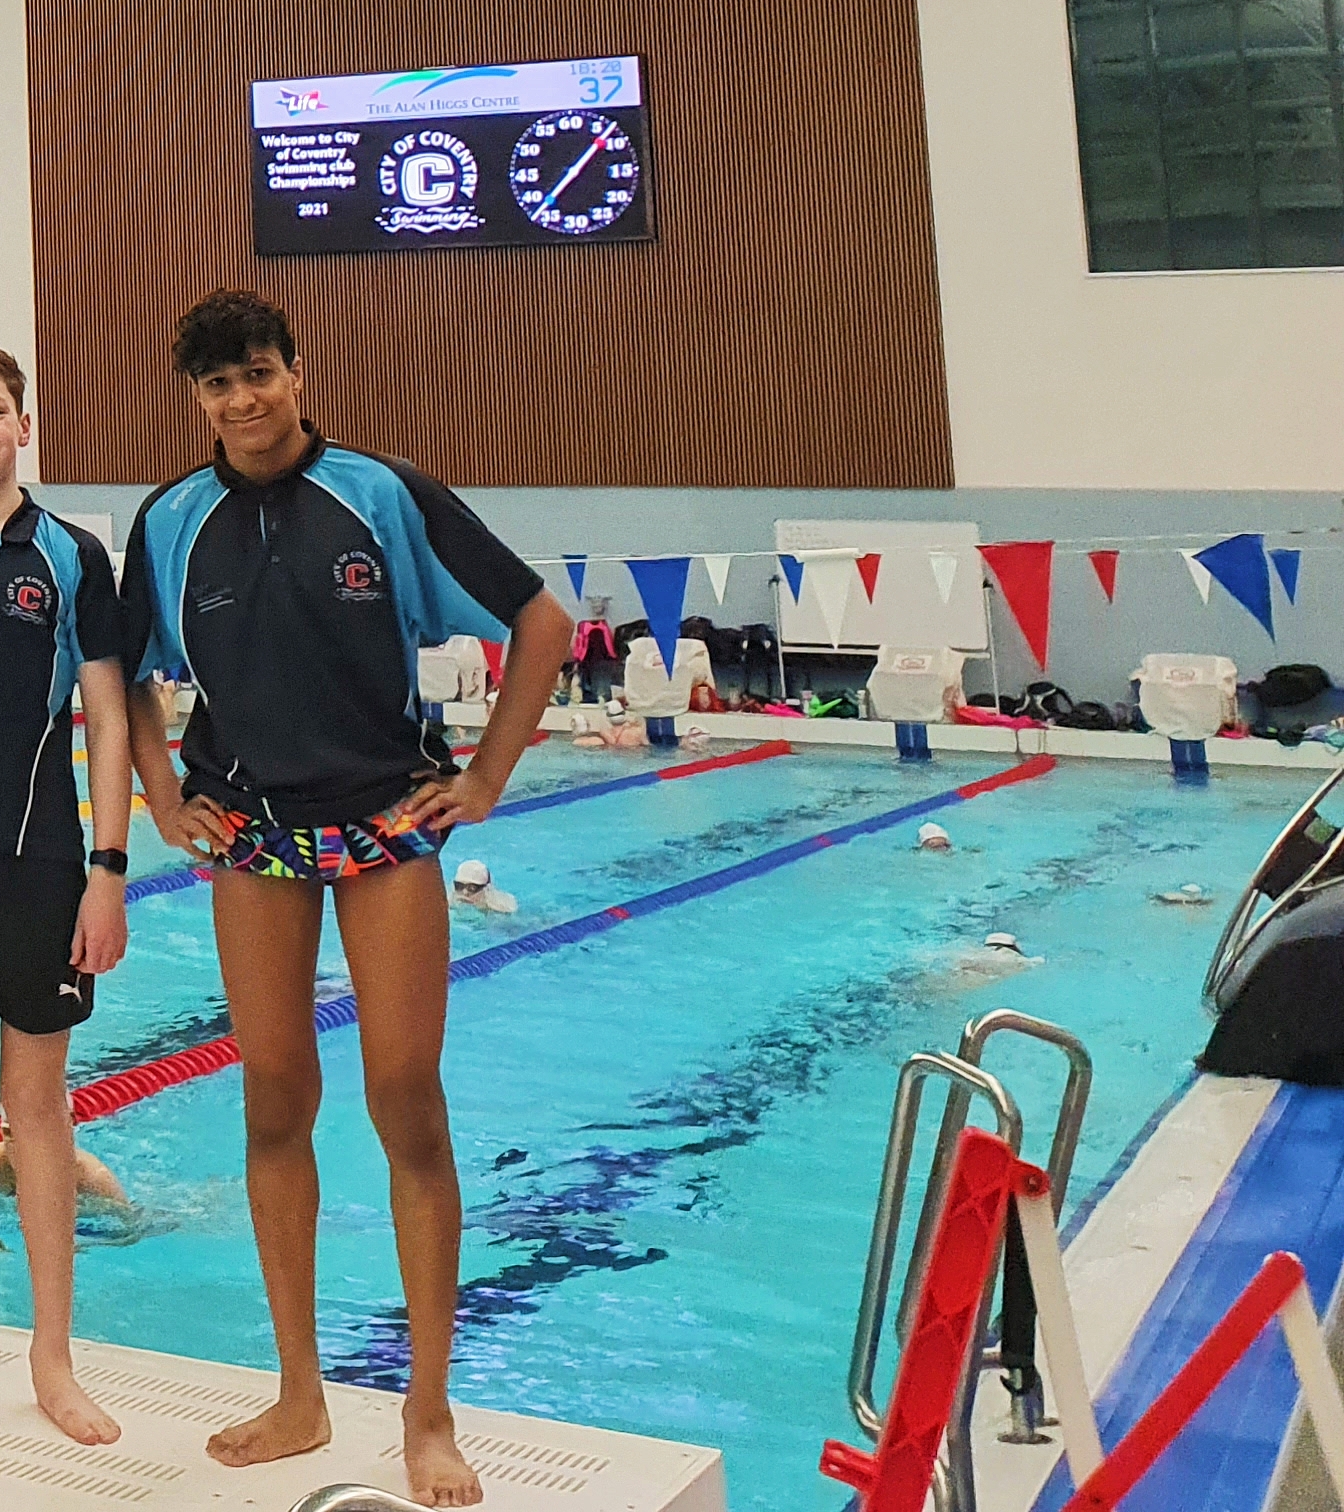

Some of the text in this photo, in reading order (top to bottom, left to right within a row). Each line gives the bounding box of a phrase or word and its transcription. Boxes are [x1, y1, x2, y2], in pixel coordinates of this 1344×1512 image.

[579, 75, 623, 104] 37
[535, 123, 556, 137] 55
[558, 115, 583, 130] 60
[591, 120, 603, 134] 5
[261, 131, 361, 148] Welcome to City
[606, 136, 626, 151] 10
[275, 147, 347, 160] of Coventry
[519, 143, 541, 157] 50
[267, 158, 356, 175] Swimming club
[379, 130, 478, 199] CITY OF COVENTRY
[610, 163, 633, 179] 15
[269, 173, 356, 190] Championships
[401, 152, 455, 207] C
[514, 168, 539, 182] 45
[522, 190, 543, 203] 40
[606, 190, 628, 203] 20
[298, 202, 328, 217] 2021
[540, 209, 561, 223] 35
[591, 206, 613, 220] 25
[390, 210, 471, 226] Swimming
[564, 214, 589, 229] 30
[344, 563, 370, 588] C
[17, 586, 42, 609] C
